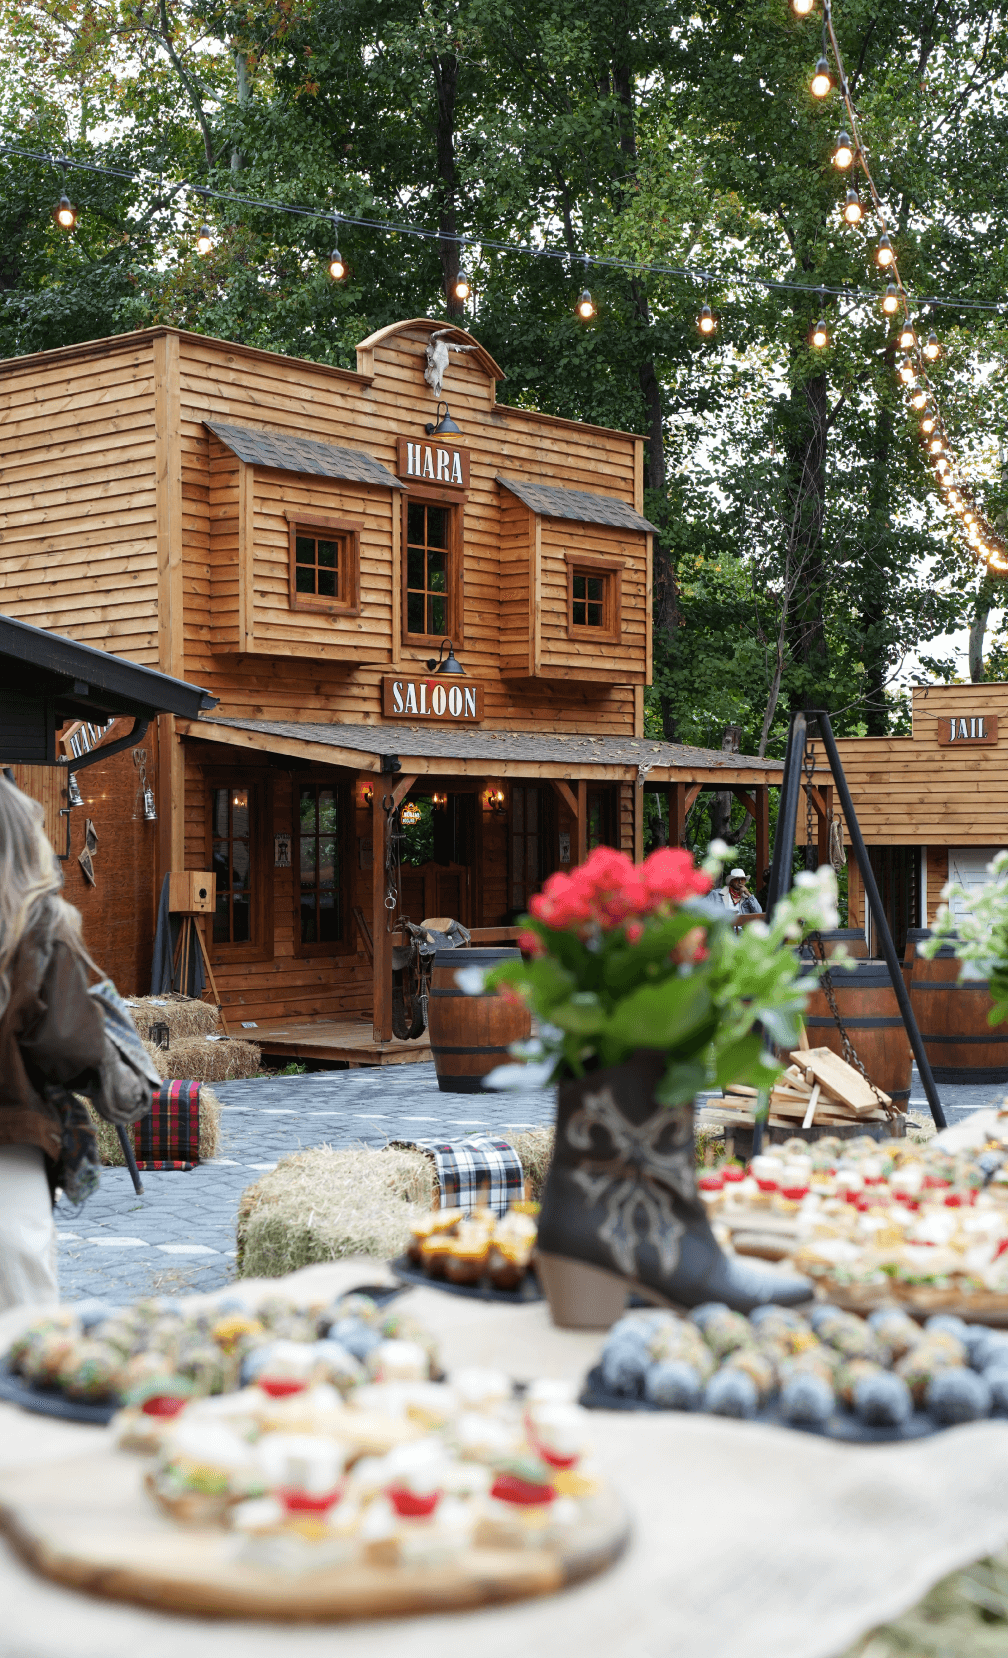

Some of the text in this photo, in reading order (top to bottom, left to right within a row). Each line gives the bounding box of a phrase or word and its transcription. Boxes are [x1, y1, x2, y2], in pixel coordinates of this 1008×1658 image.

[406, 442, 463, 484] HARA
[393, 681, 477, 717] SALOON
[949, 717, 988, 742] JAIL
